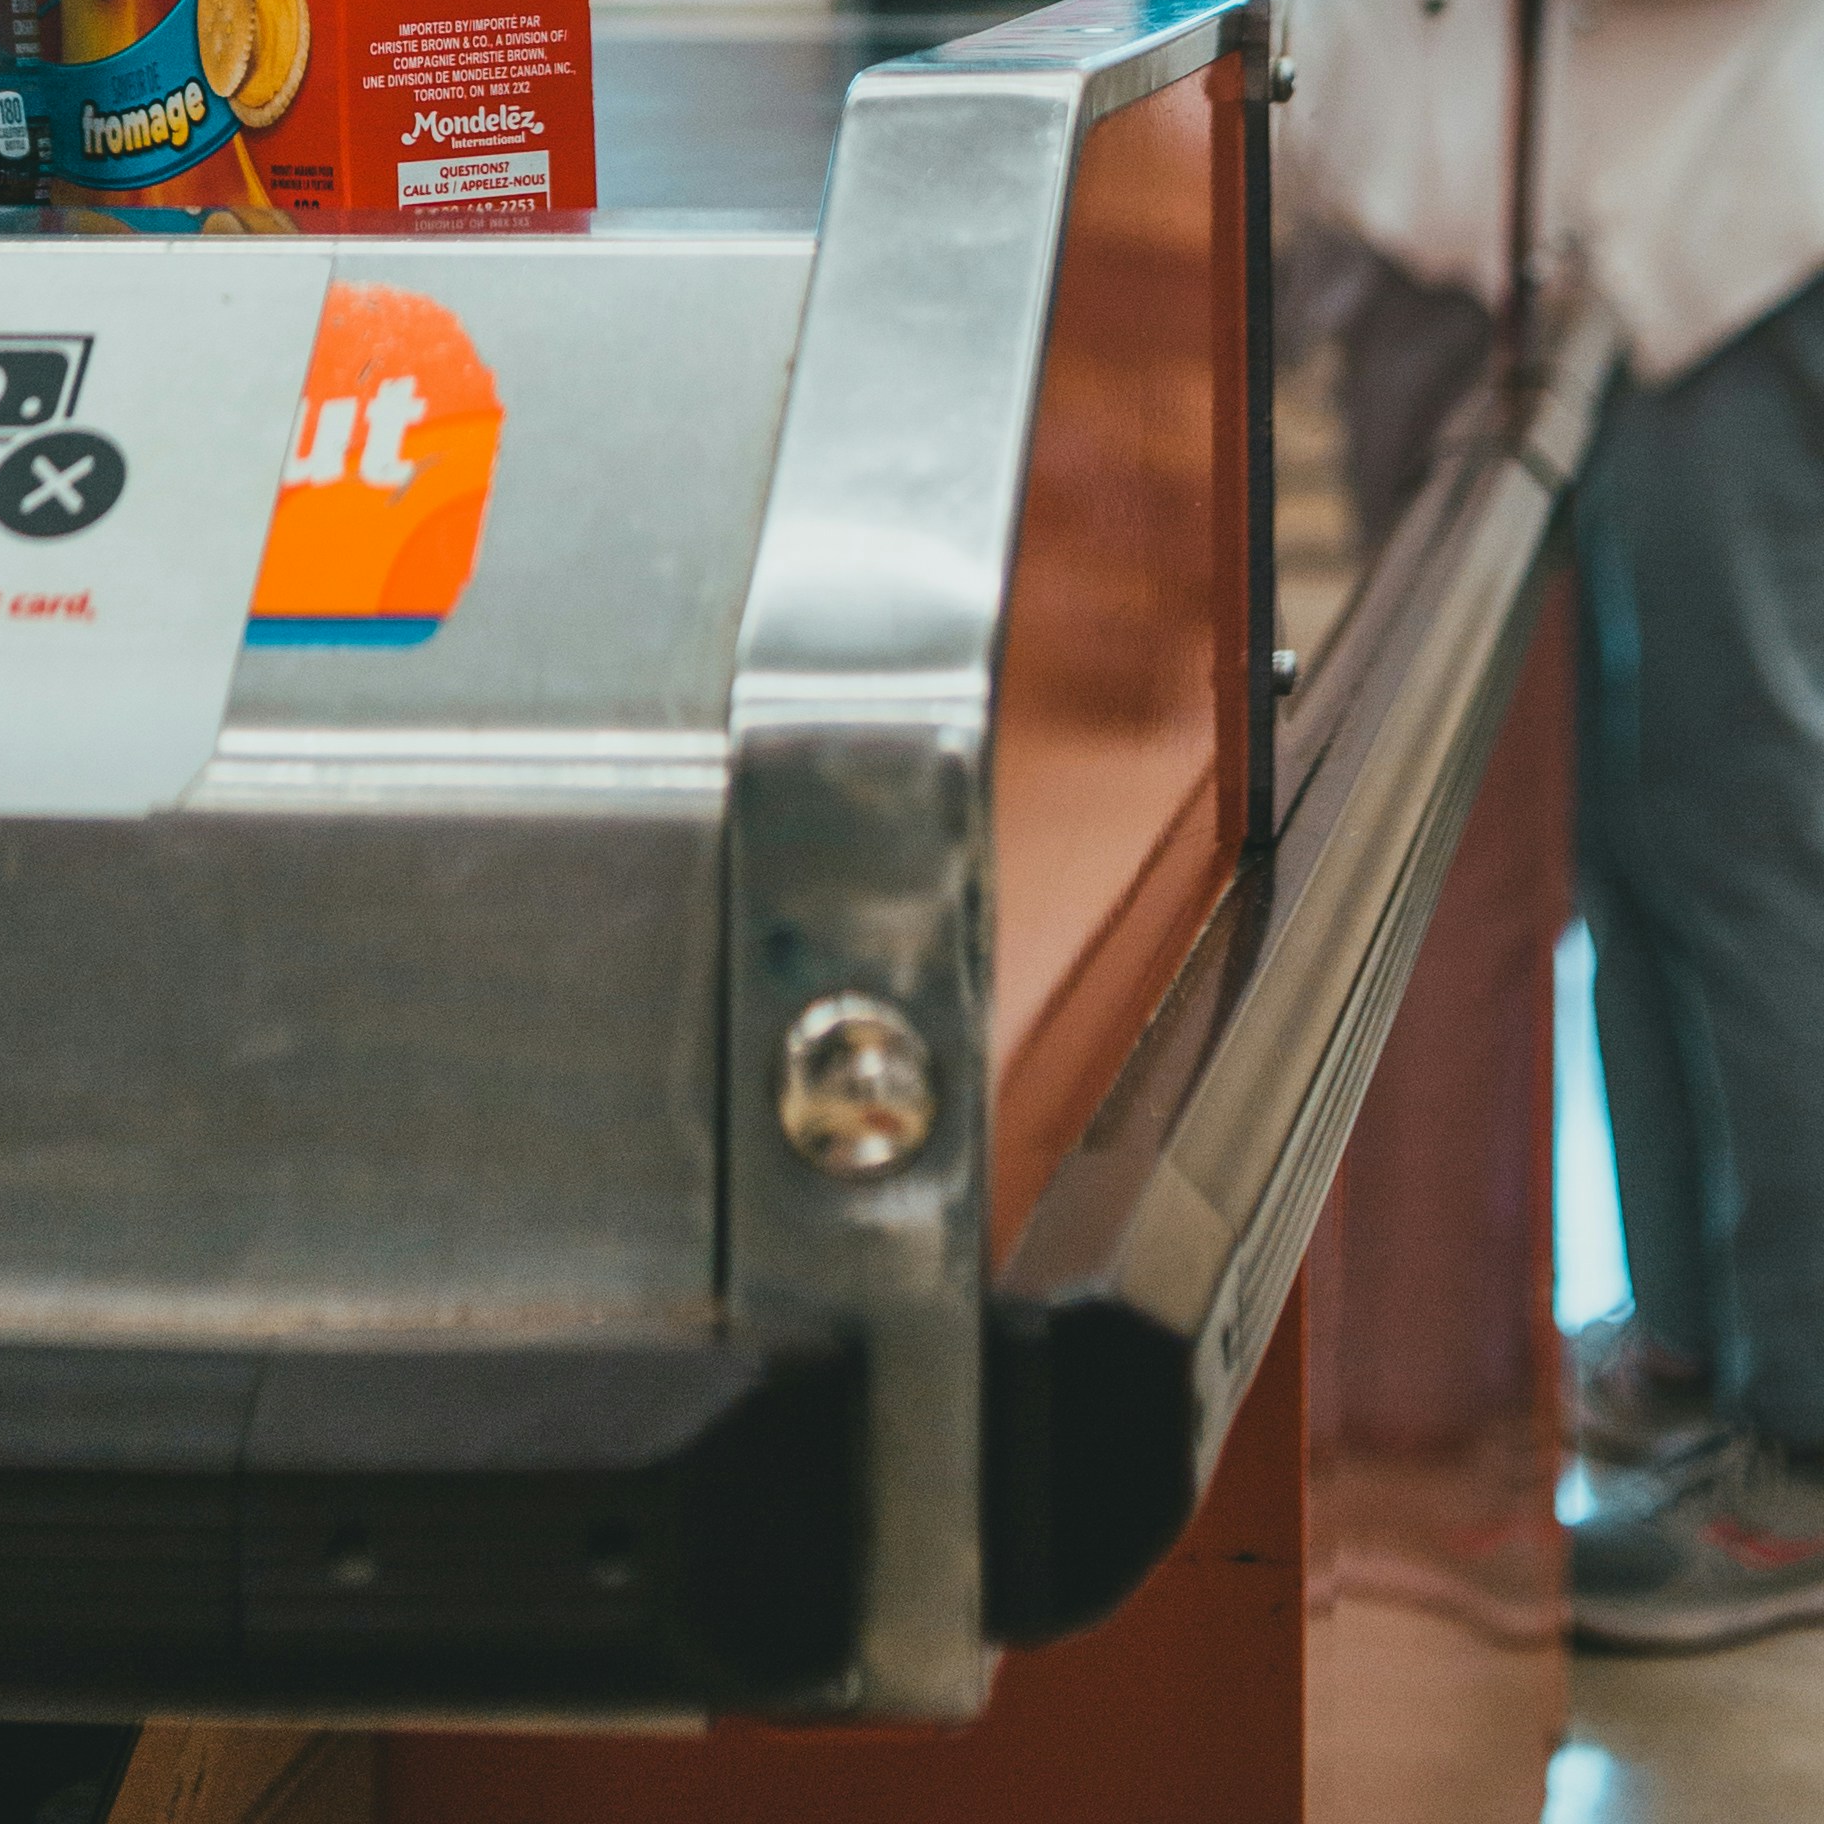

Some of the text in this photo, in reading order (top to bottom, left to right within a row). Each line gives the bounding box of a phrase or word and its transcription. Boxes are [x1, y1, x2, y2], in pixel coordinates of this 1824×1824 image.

[82, 81, 206, 155] fromage
[451, 132, 525, 149] International
[440, 162, 510, 178] QUESTIONS?
[403, 174, 545, 197] CALL US / APPELEZ-NOUS
